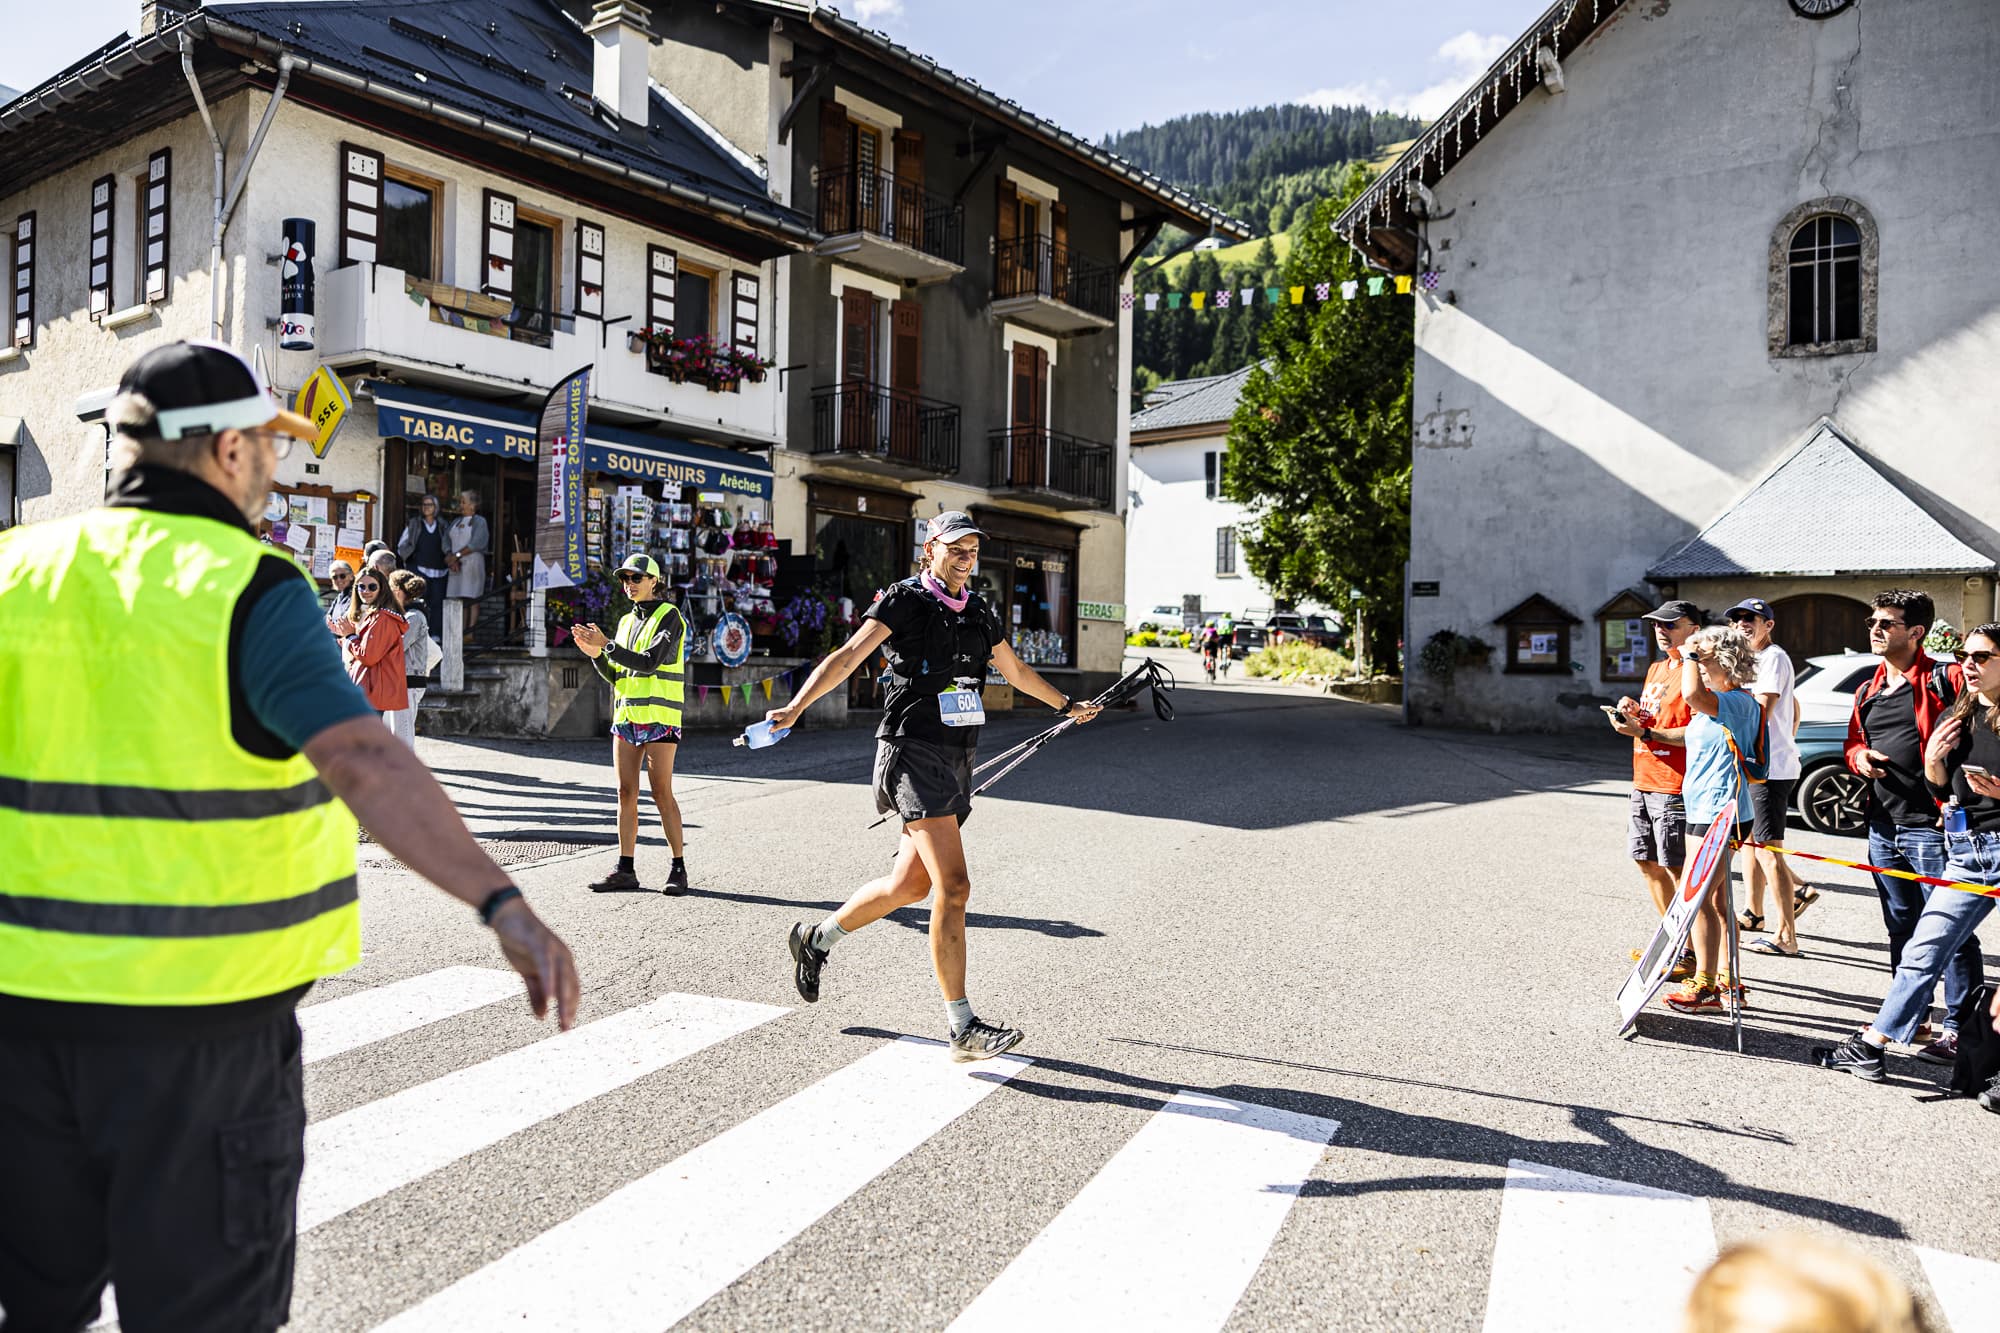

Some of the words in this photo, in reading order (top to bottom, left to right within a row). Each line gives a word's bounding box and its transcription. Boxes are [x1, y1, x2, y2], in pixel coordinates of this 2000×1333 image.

[400, 415, 474, 445] TABAC
[607, 453, 706, 484] SOUVENIRS
[958, 694, 977, 711] 604
